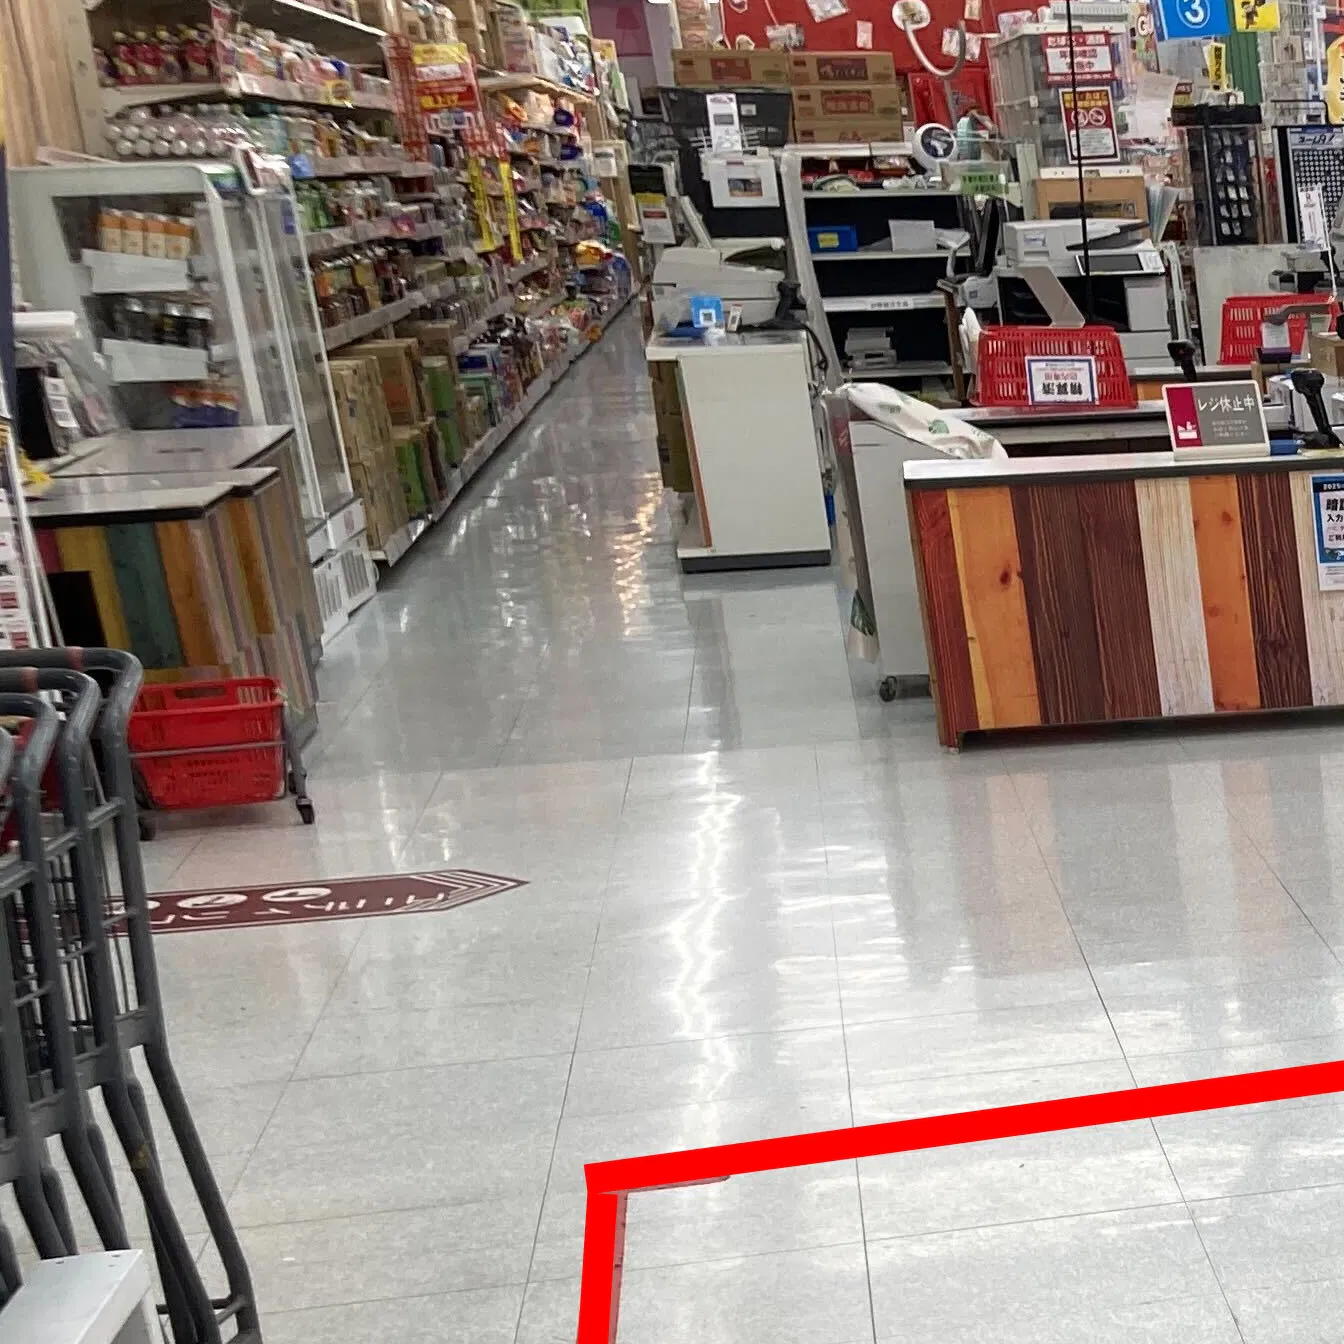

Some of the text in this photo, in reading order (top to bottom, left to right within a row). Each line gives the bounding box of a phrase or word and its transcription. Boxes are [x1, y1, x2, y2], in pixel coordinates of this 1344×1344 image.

[1198, 393, 1255, 413] レジ休止中
